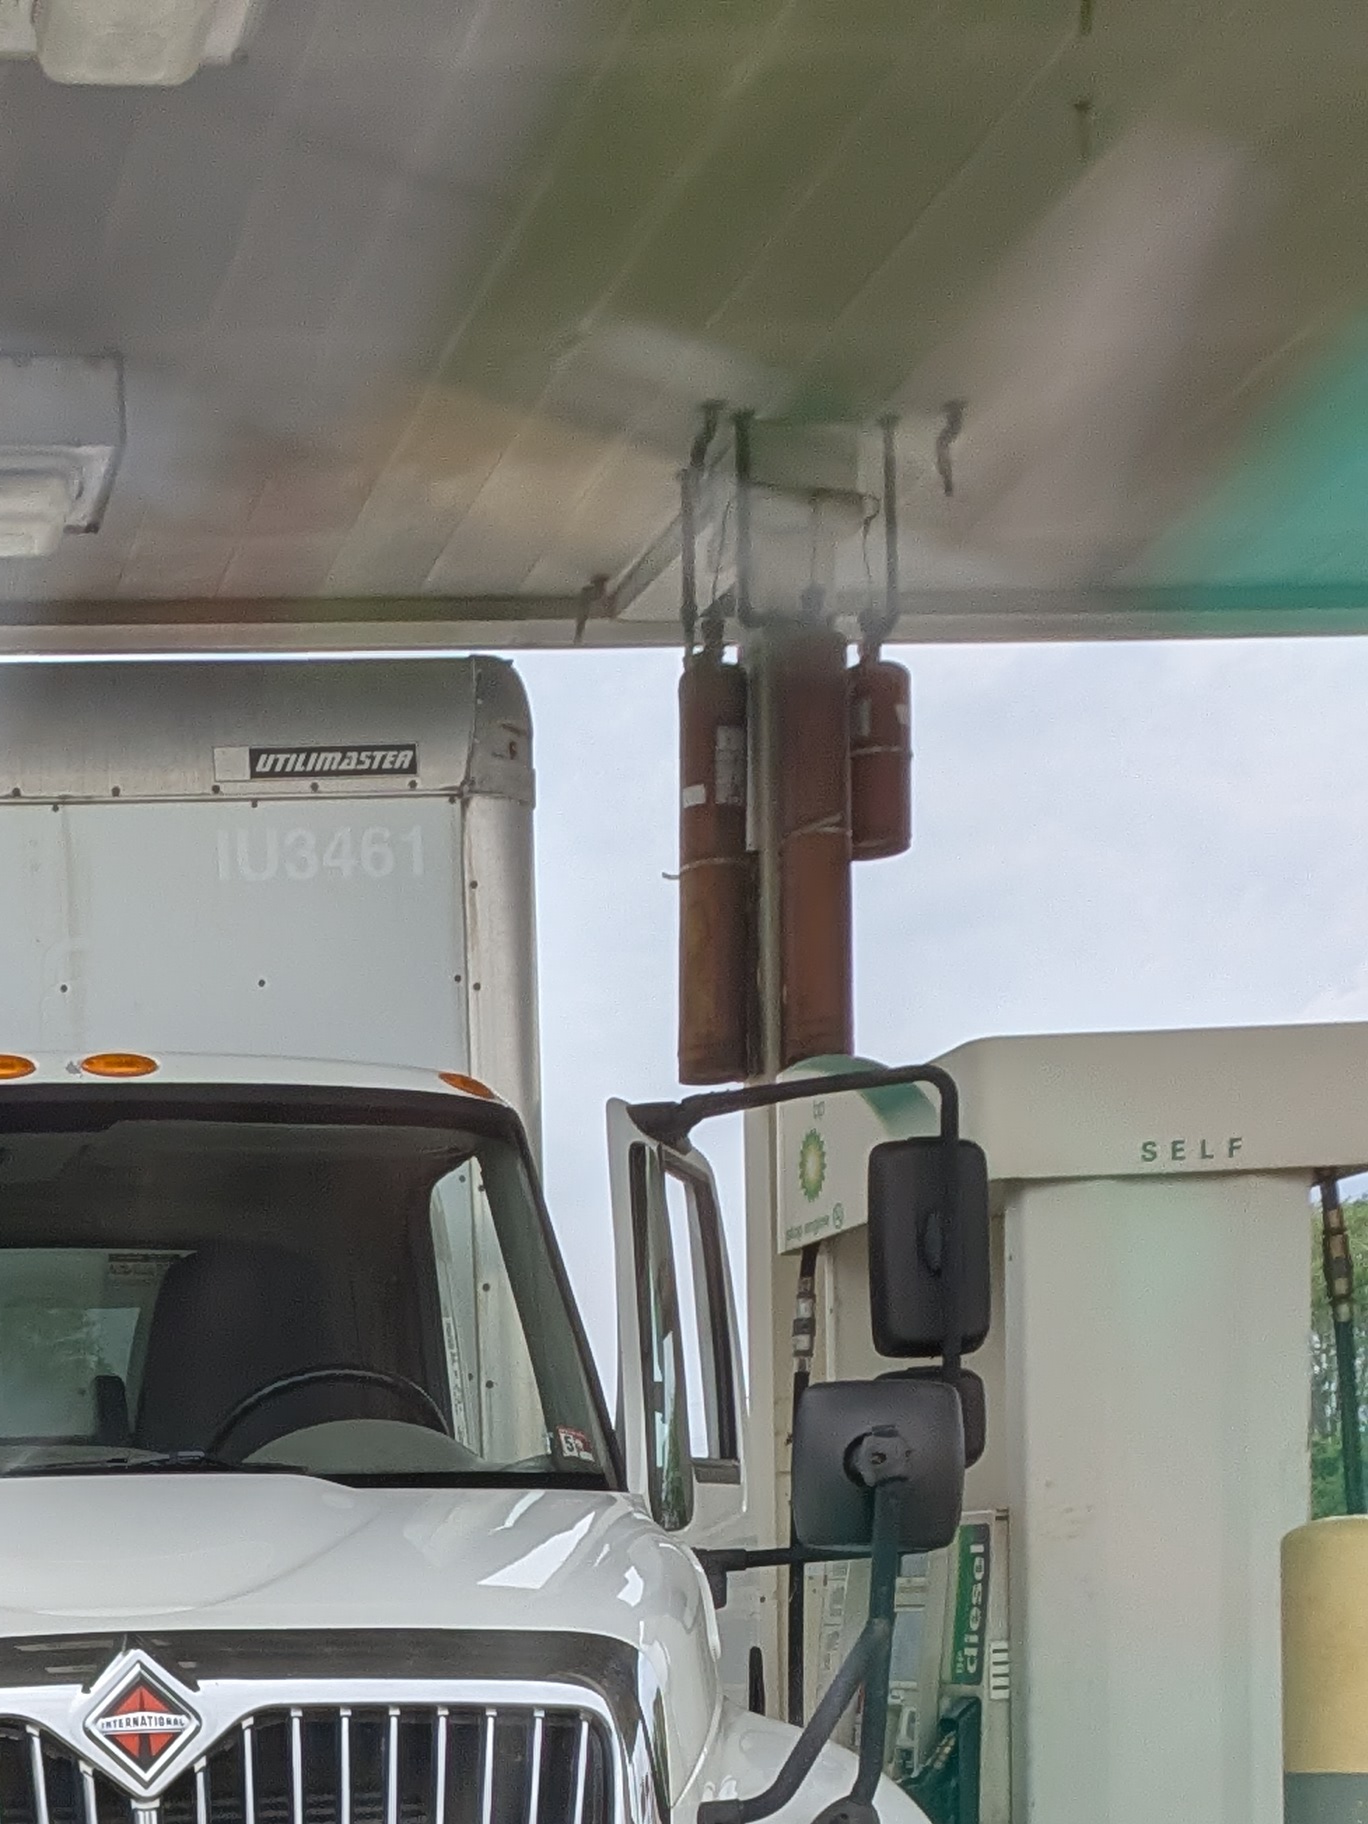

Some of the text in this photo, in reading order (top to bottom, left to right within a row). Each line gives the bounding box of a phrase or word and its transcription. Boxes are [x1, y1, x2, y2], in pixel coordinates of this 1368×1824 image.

[255, 749, 413, 772] UTILIMASTER
[1141, 1137, 1243, 1162] SELF
[964, 1544, 984, 1674] diesel
[101, 1715, 185, 1729] INTERNATIONAL
